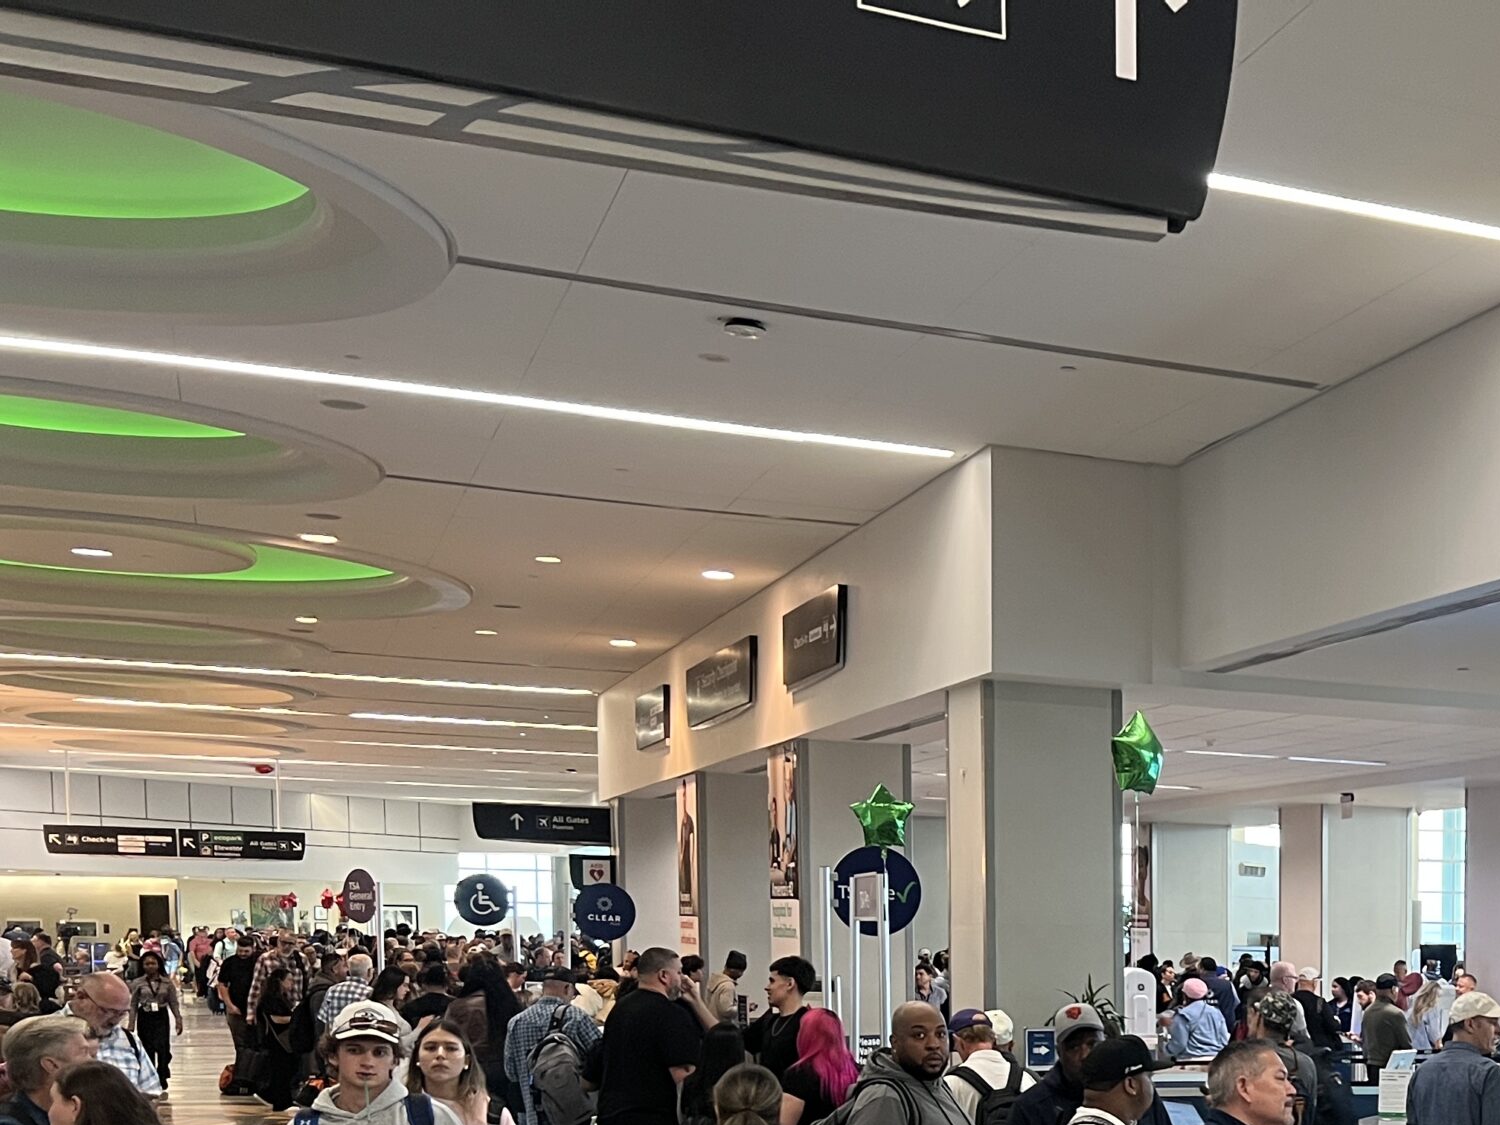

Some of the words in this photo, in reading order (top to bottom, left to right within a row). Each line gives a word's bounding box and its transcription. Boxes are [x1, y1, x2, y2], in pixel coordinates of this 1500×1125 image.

[566, 816, 589, 824] Gates
[349, 882, 360, 890] TSA
[349, 891, 373, 900] General
[350, 902, 365, 912] Entry
[587, 913, 621, 922] CLEAR
